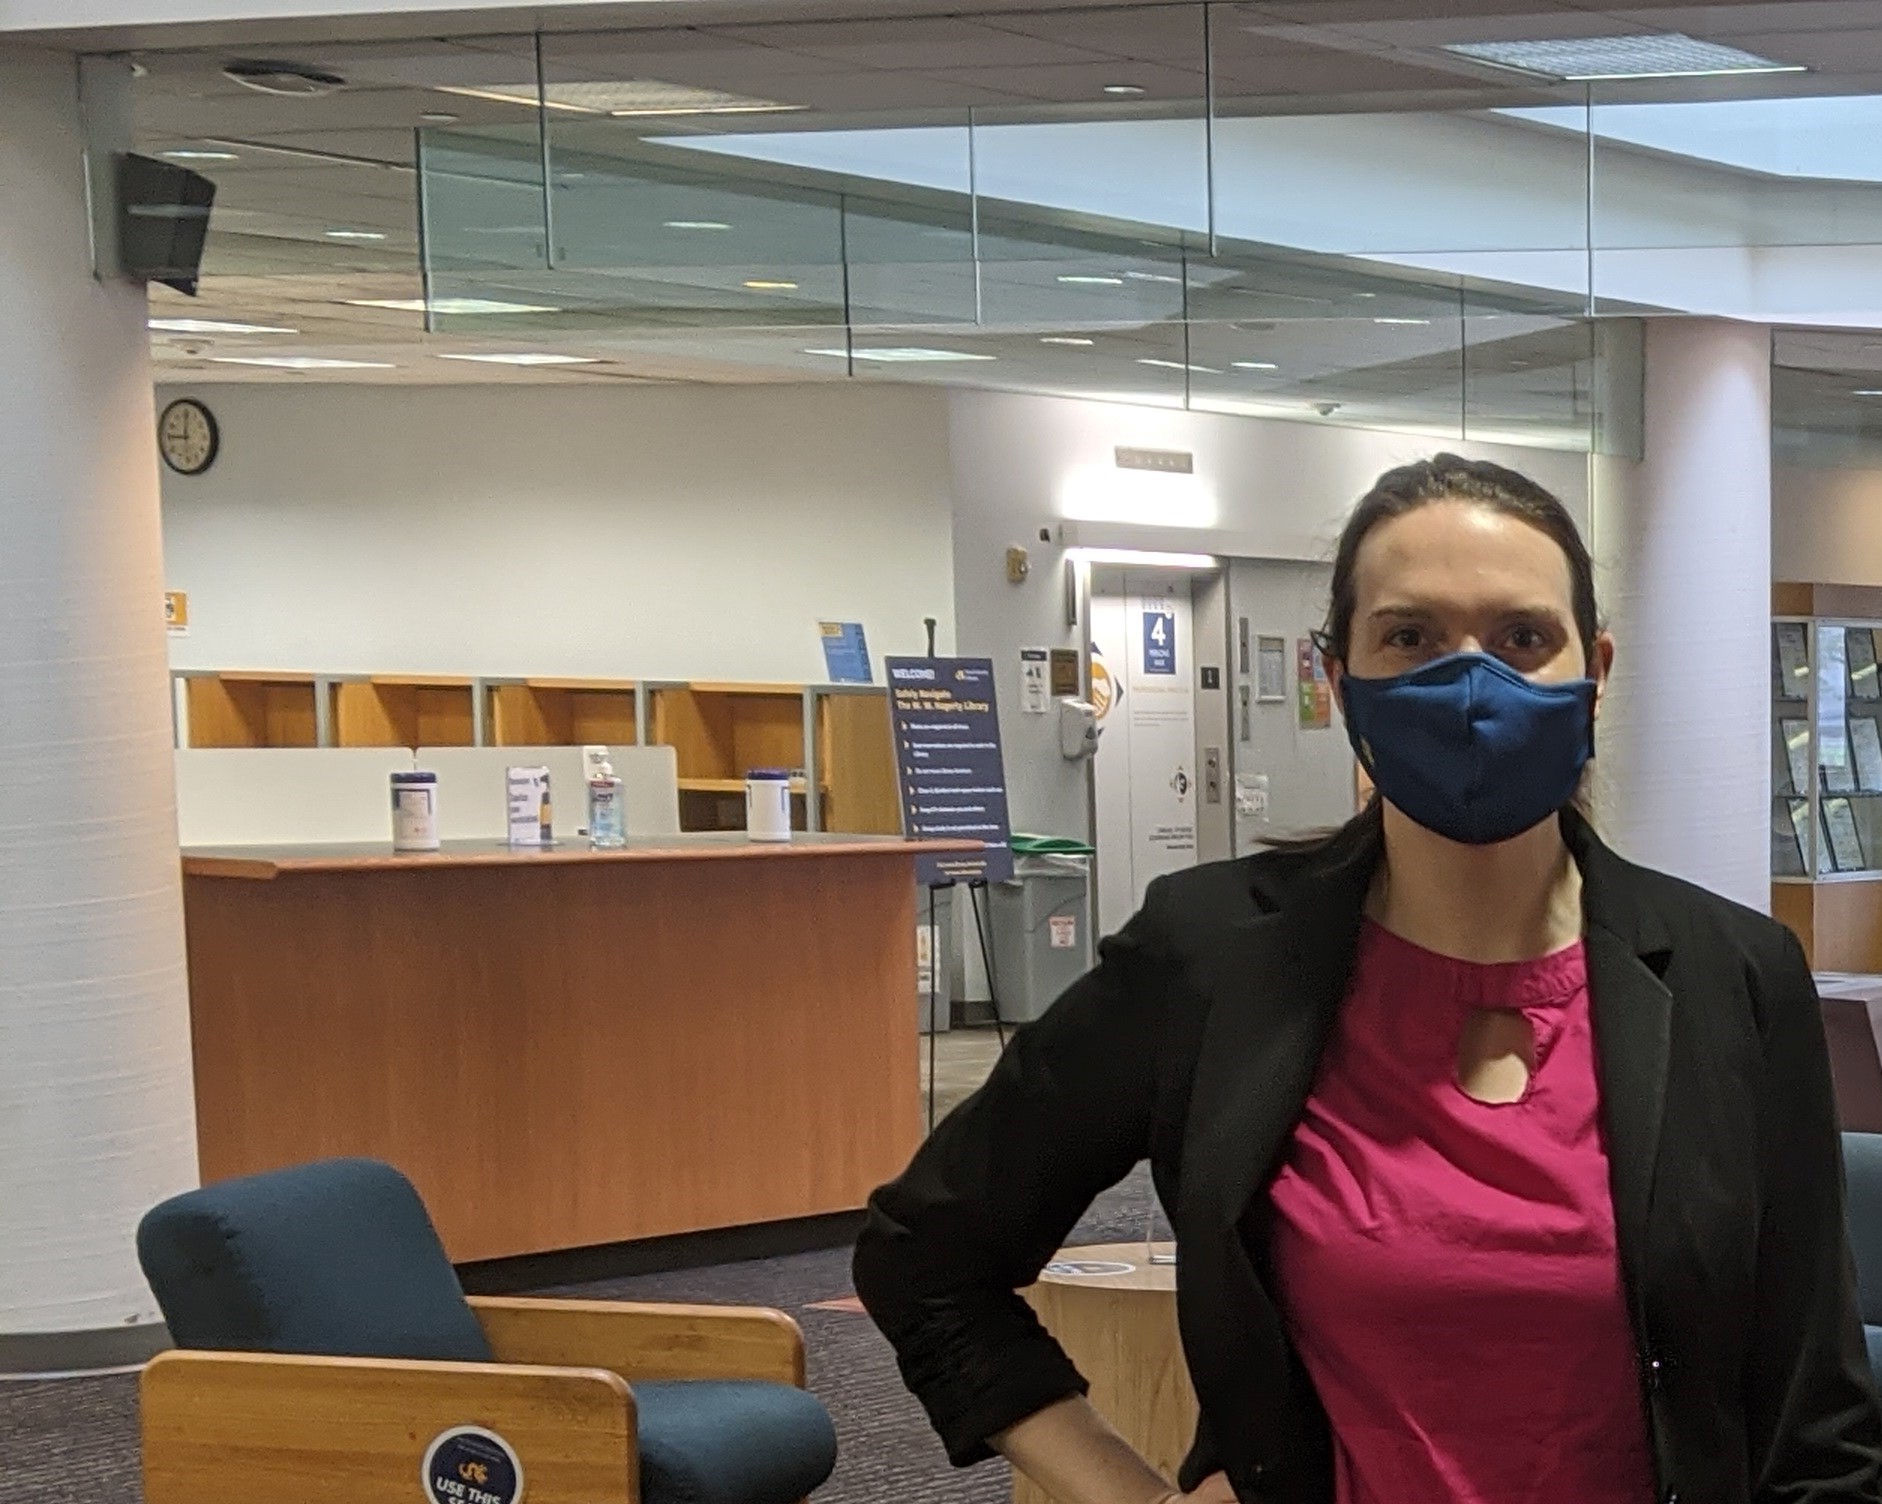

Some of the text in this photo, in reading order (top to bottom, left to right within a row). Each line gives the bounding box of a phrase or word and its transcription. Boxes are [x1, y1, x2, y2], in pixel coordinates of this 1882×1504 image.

[1151, 617, 1166, 646] 4
[896, 700, 911, 710] The
[963, 701, 989, 712] Library
[436, 1476, 466, 1497] USE
